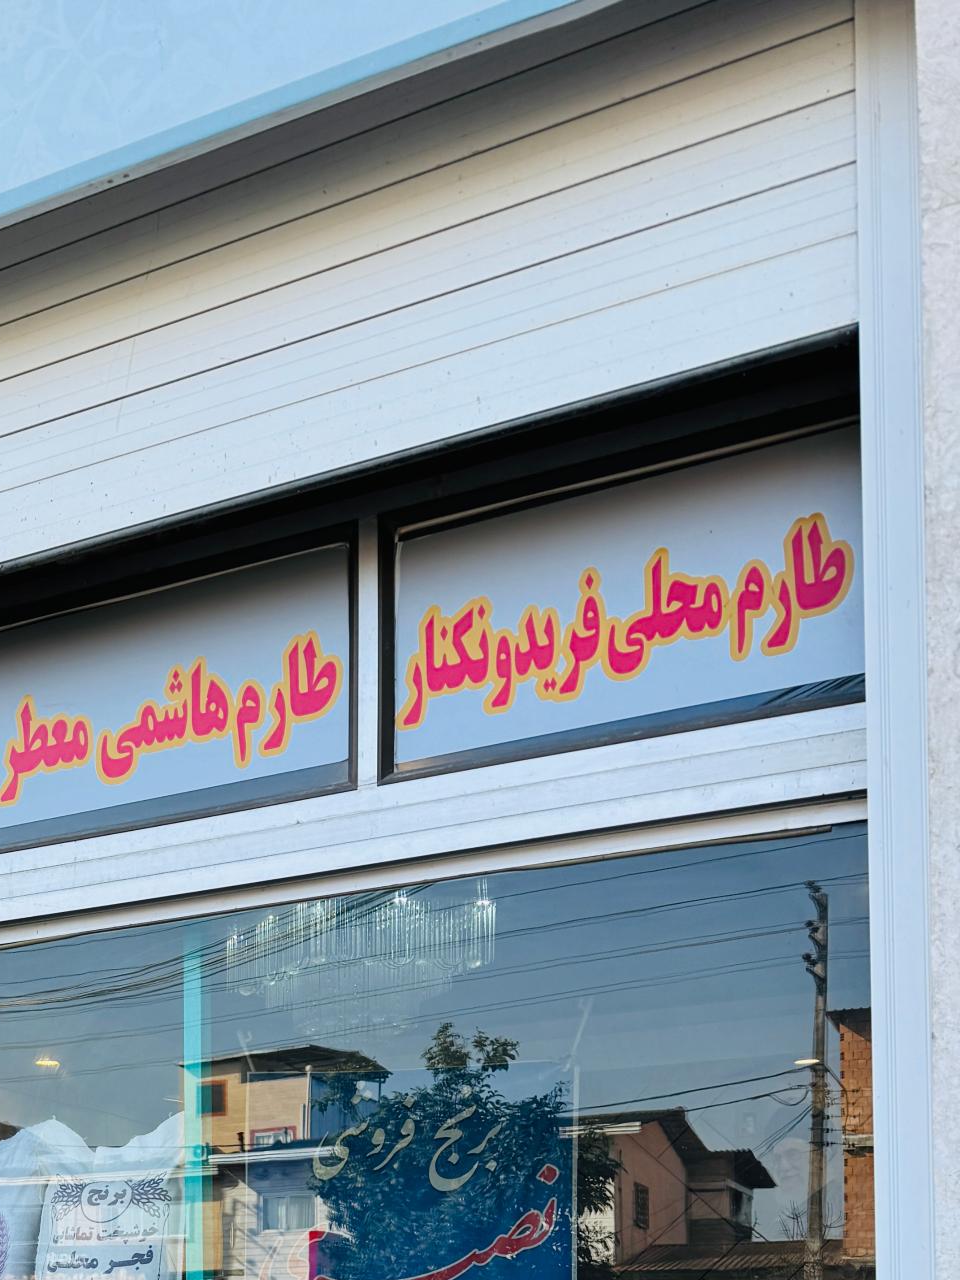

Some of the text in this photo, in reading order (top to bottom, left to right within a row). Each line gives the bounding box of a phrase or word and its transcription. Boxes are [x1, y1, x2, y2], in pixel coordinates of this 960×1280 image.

[397, 516, 851, 729] طارم محلی فریدونکنار
[98, 660, 230, 781] هاشمی
[236, 634, 339, 763] طارم
[86, 1185, 127, 1206] برنج
